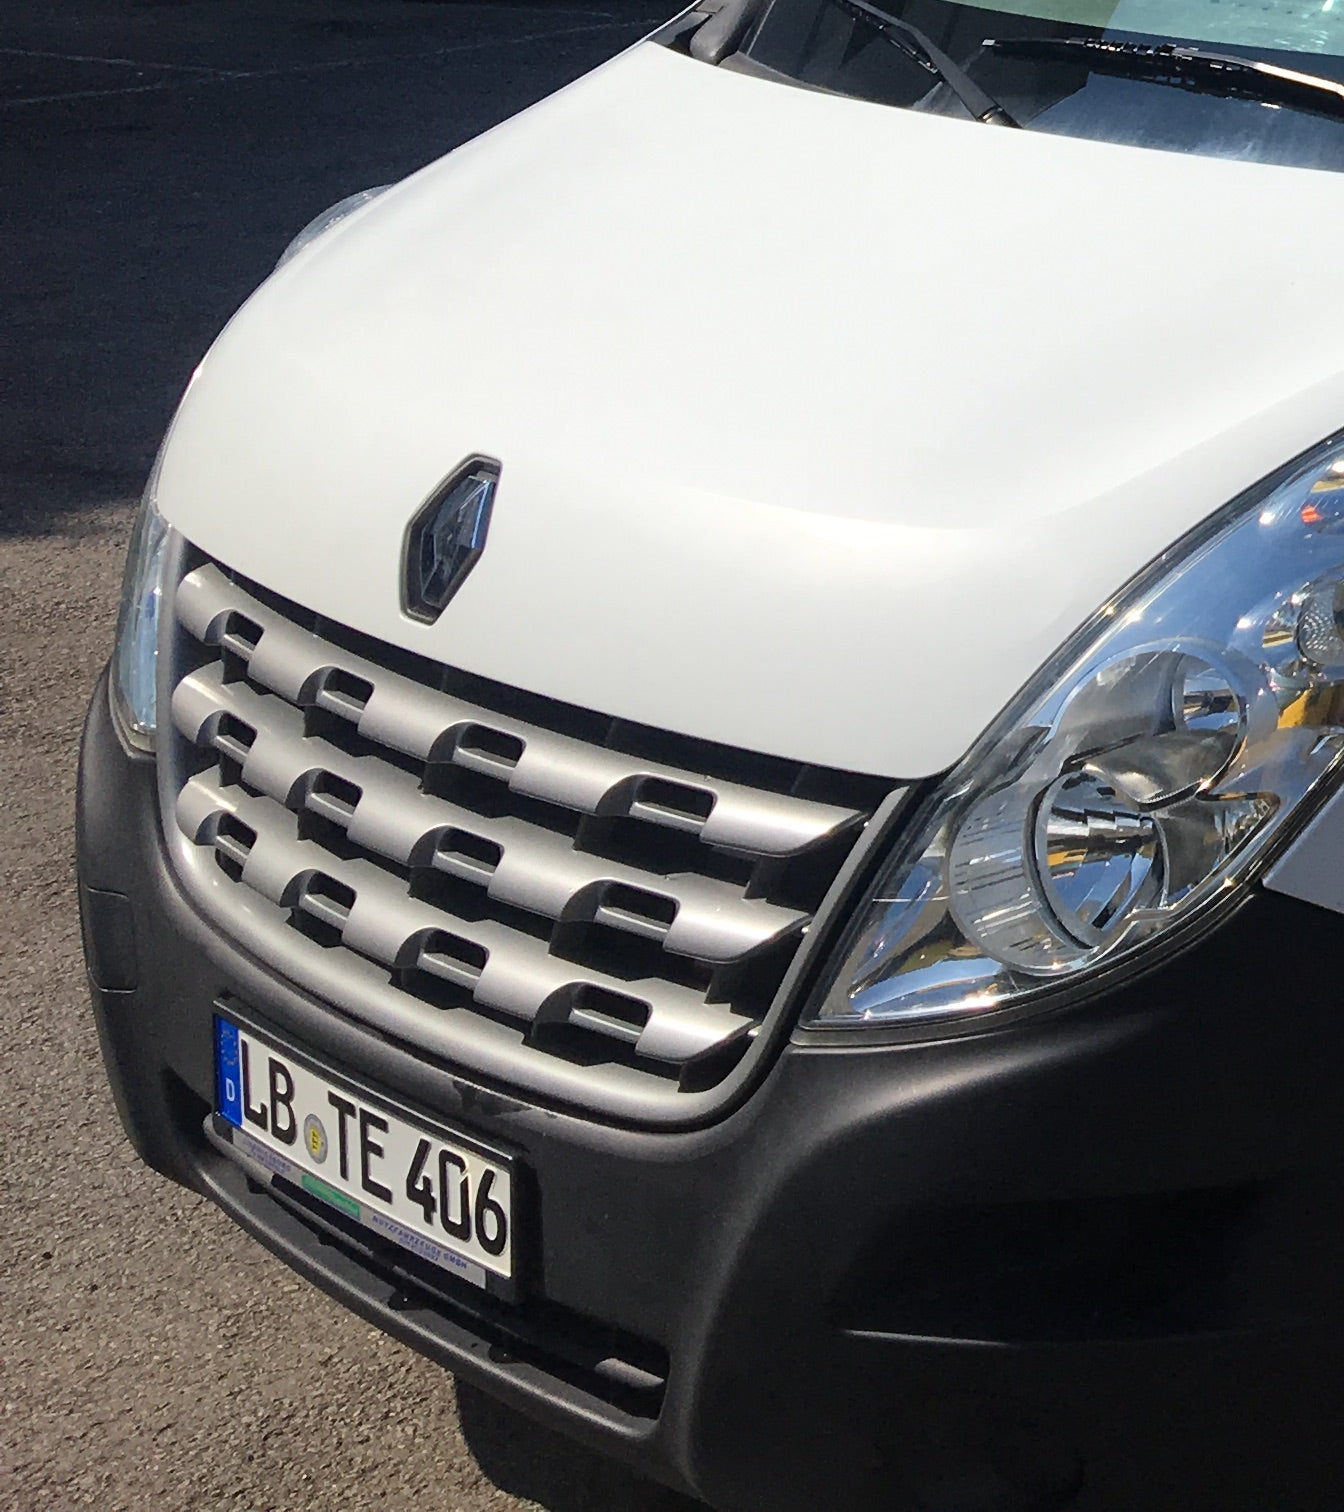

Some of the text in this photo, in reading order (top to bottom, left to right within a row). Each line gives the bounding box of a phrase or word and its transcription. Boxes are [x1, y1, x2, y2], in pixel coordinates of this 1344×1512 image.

[225, 1076, 236, 1103] D
[240, 1038, 508, 1258] LB TE 406
